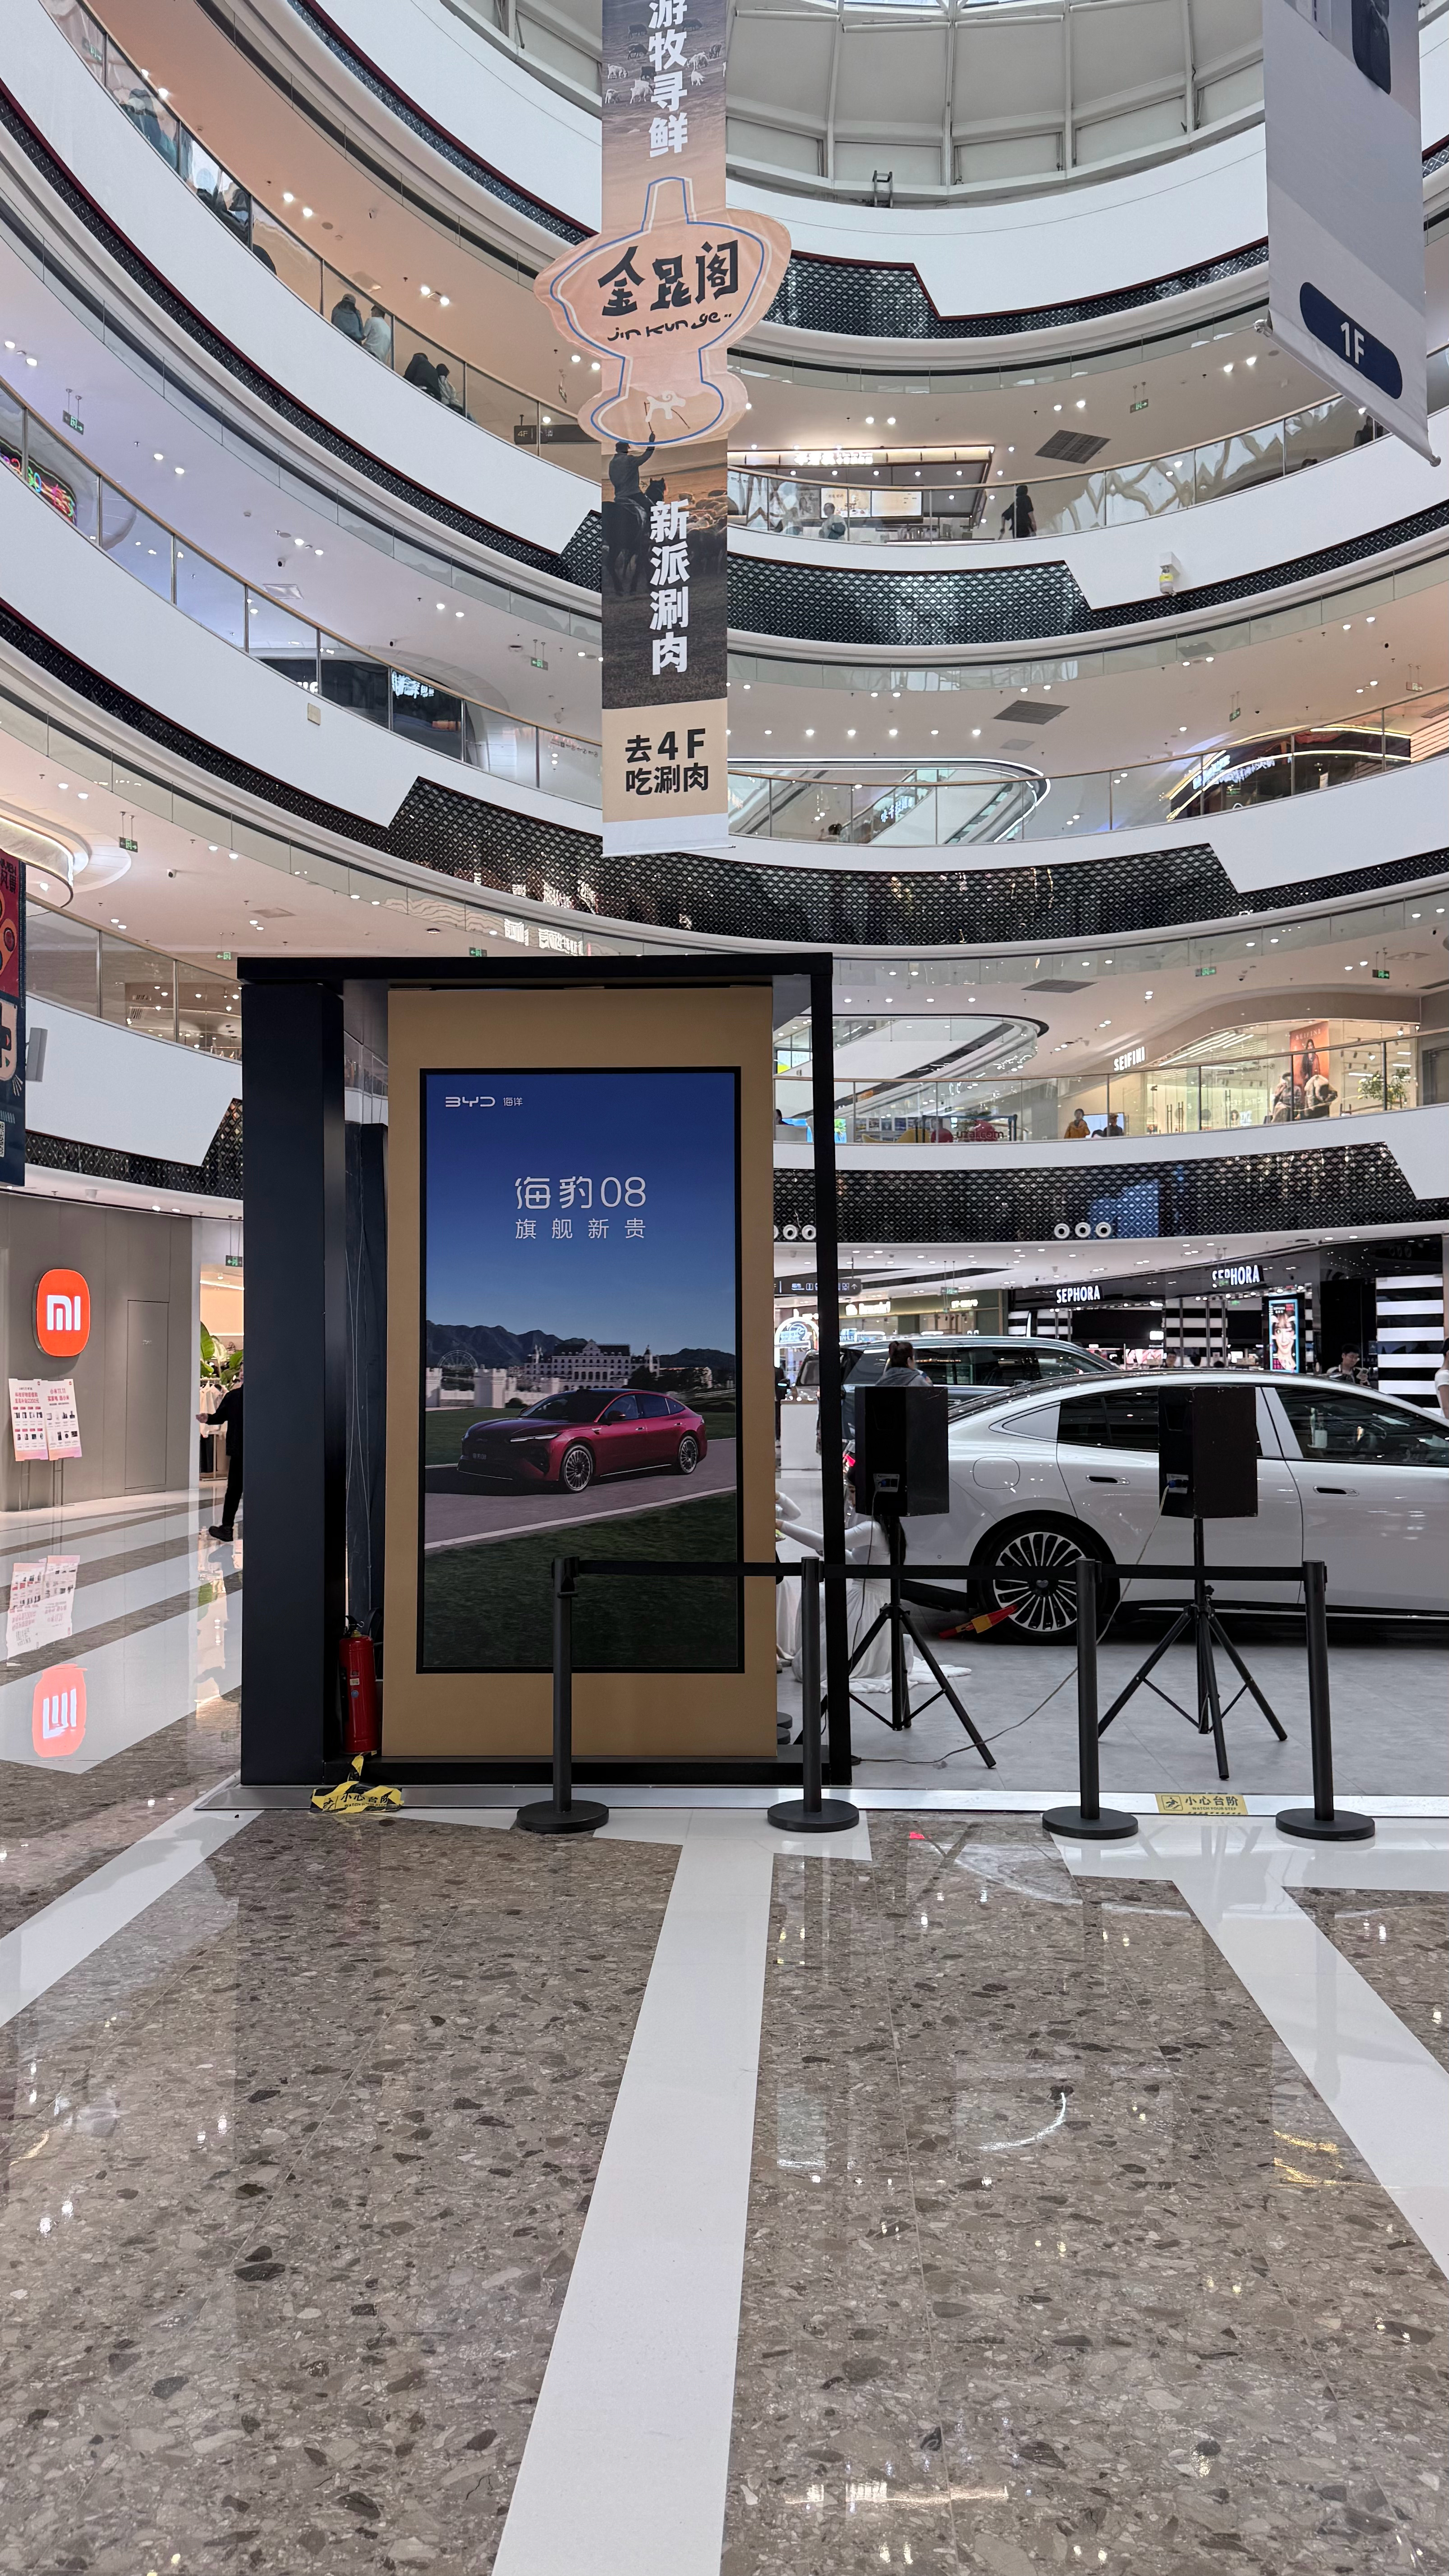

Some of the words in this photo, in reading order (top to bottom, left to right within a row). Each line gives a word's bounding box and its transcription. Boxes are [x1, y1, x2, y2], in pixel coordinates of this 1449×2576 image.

[598, 239, 739, 317] 金昆阁
[1340, 321, 1365, 365] 1F
[649, 498, 690, 676] 新派涮肉
[625, 762, 709, 796] 吃涮肉
[445, 1096, 496, 1108] BYD
[503, 1096, 524, 1107] 海洋
[515, 1175, 646, 1210] 海豹08
[515, 1218, 646, 1239] 旗舰新贵
[1056, 1285, 1100, 1304] SEPHORA
[1185, 1796, 1238, 1806] 小心台阶
